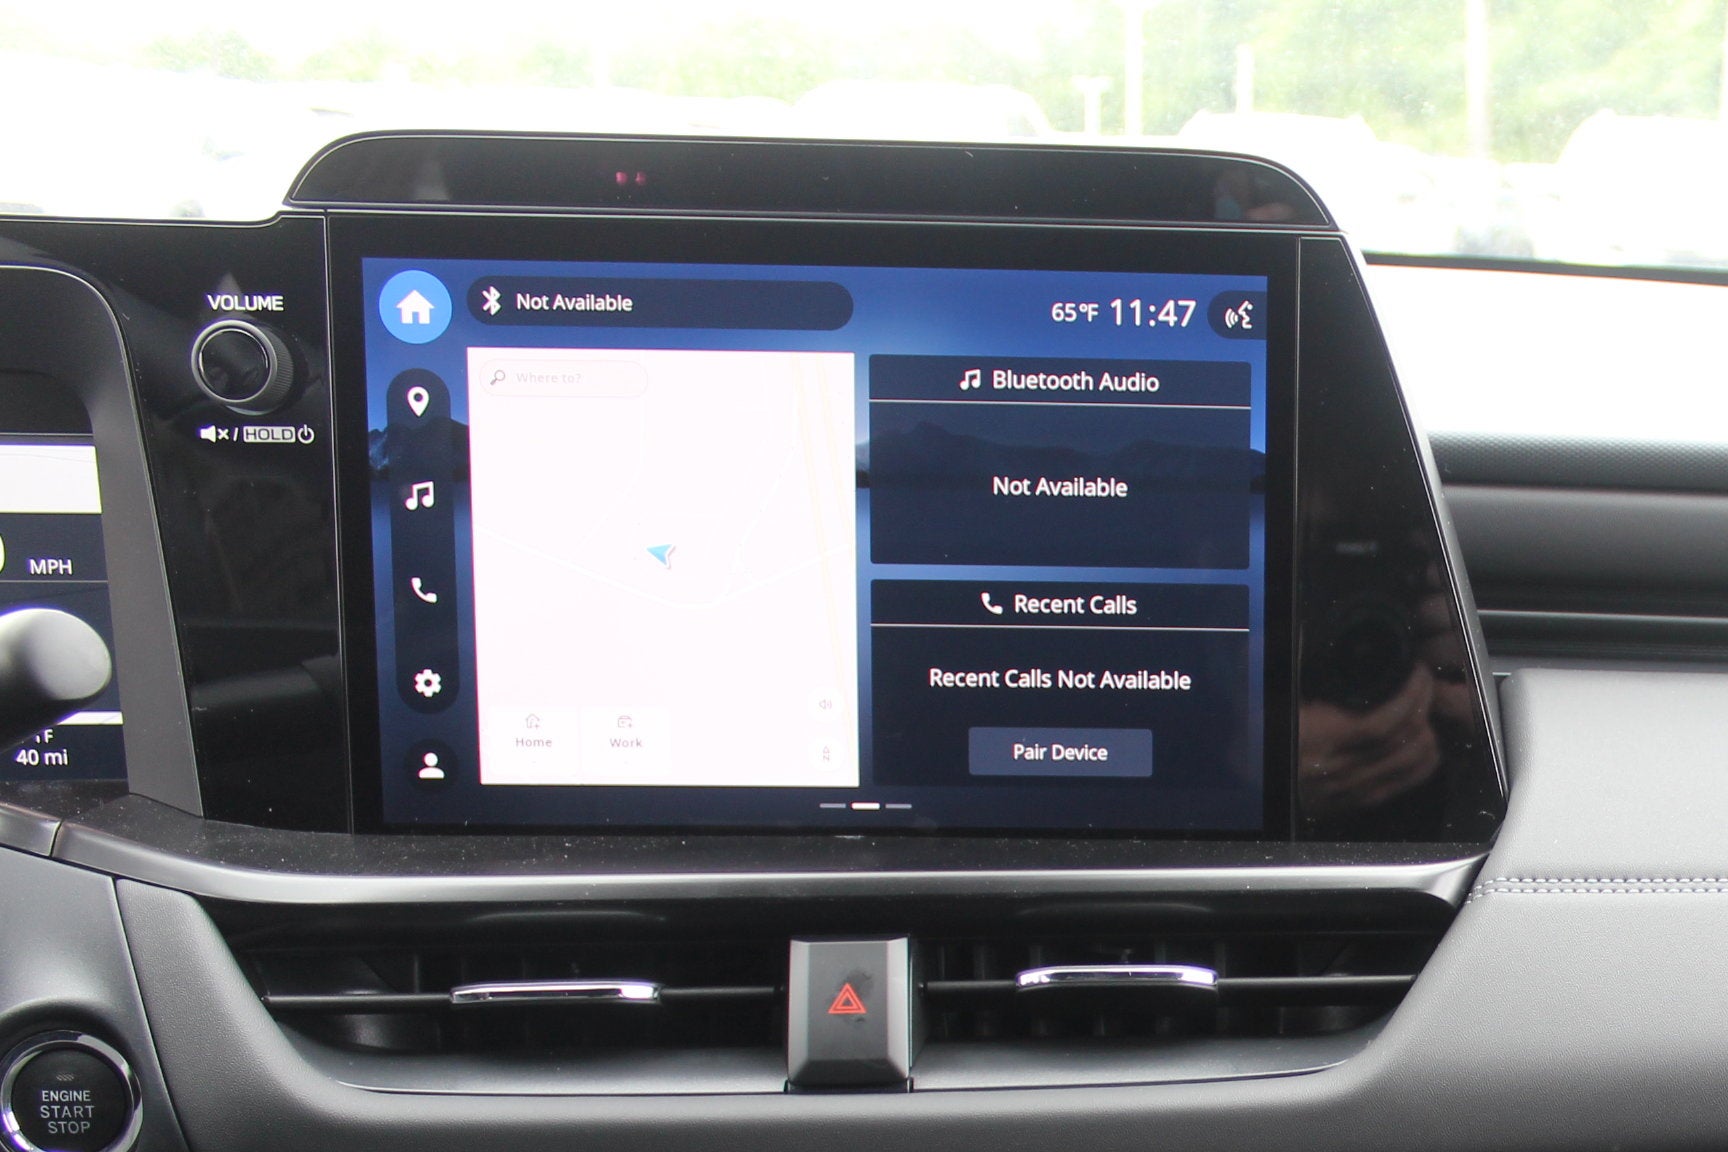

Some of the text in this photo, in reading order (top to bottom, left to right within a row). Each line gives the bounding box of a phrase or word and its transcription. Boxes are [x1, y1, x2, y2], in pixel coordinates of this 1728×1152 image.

[207, 294, 285, 312] VOLUME
[516, 293, 633, 312] Not Available
[1051, 298, 1197, 328] 65°F 11:47
[516, 371, 559, 383] Where
[992, 369, 1160, 392] Bluetooth Audio
[245, 428, 294, 442] HOLD
[992, 476, 1128, 498] Not Available
[29, 559, 73, 575] MPH
[1013, 594, 1138, 615] Recent Calls
[928, 668, 1192, 690] Recent Calls Not Available
[515, 737, 643, 748] Home Work
[16, 749, 68, 766] 40 mi
[1012, 743, 1108, 761] Pair Device
[41, 1090, 91, 1102] ENGINE
[40, 1105, 95, 1119] START
[47, 1121, 91, 1134] STOP
